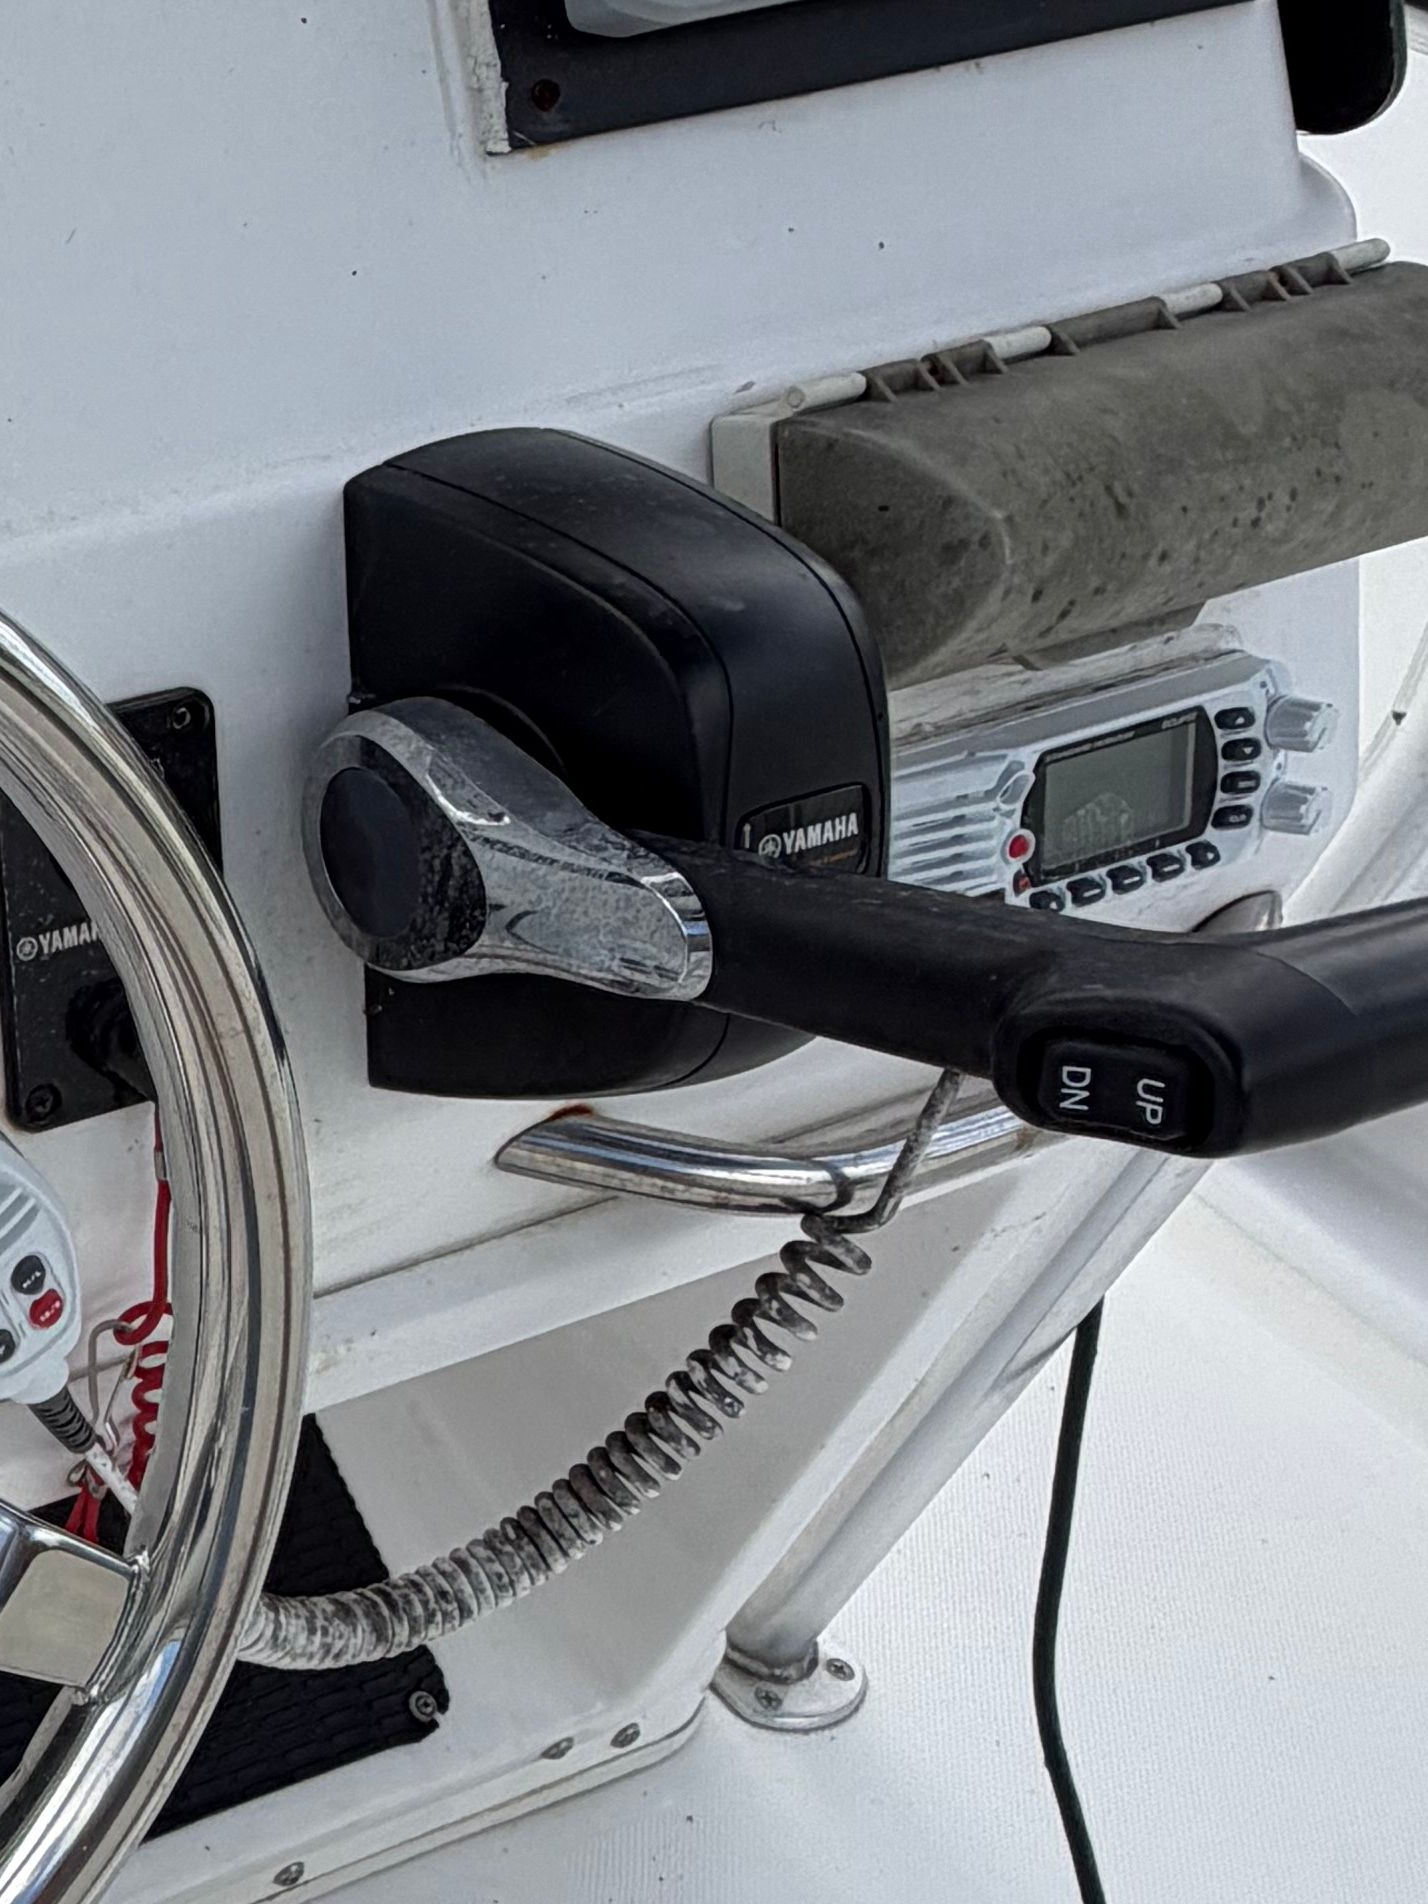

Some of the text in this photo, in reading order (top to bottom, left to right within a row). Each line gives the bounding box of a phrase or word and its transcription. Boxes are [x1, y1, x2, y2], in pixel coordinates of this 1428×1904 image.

[782, 812, 860, 855] YAMAHA
[1059, 1065, 1092, 1112] DN
[1136, 1078, 1166, 1126] UP
